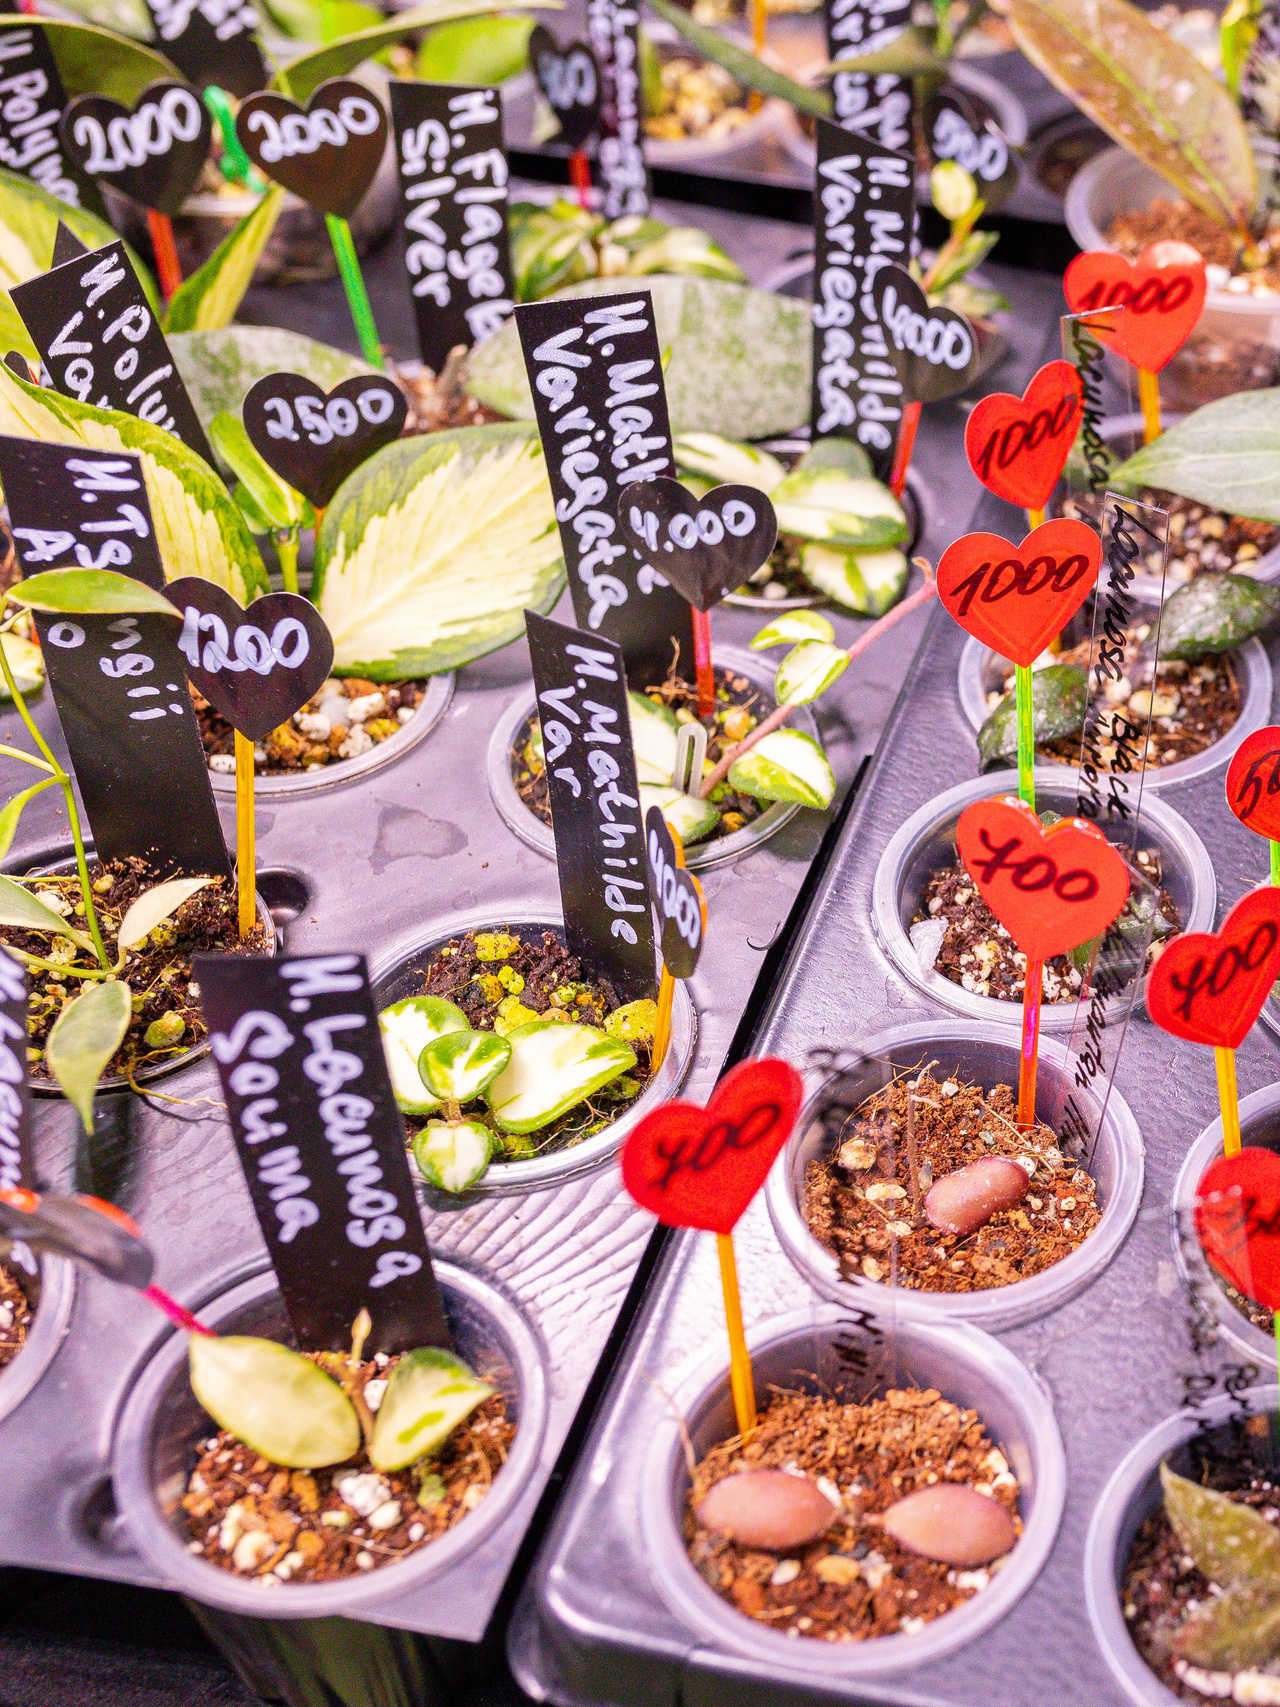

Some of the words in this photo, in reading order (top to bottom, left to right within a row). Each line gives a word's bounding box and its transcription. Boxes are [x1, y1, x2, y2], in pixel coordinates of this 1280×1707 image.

[75, 88, 201, 175] 2000
[248, 96, 380, 164] 2000
[401, 119, 456, 307] Silver
[811, 157, 863, 434] Variegata
[1080, 276, 1194, 314] 1000
[262, 388, 396, 446] 2500
[976, 393, 1079, 480] 1000
[533, 327, 628, 630] Variegata
[74, 504, 185, 721] Tsngii
[949, 553, 1091, 617] 1000
[1093, 504, 1162, 686] Lacunosa
[178, 606, 311, 675] 1200
[540, 686, 582, 798] Var
[1107, 712, 1144, 820] Black
[583, 699, 646, 945] Mathilde
[213, 1010, 319, 1244] Souma
